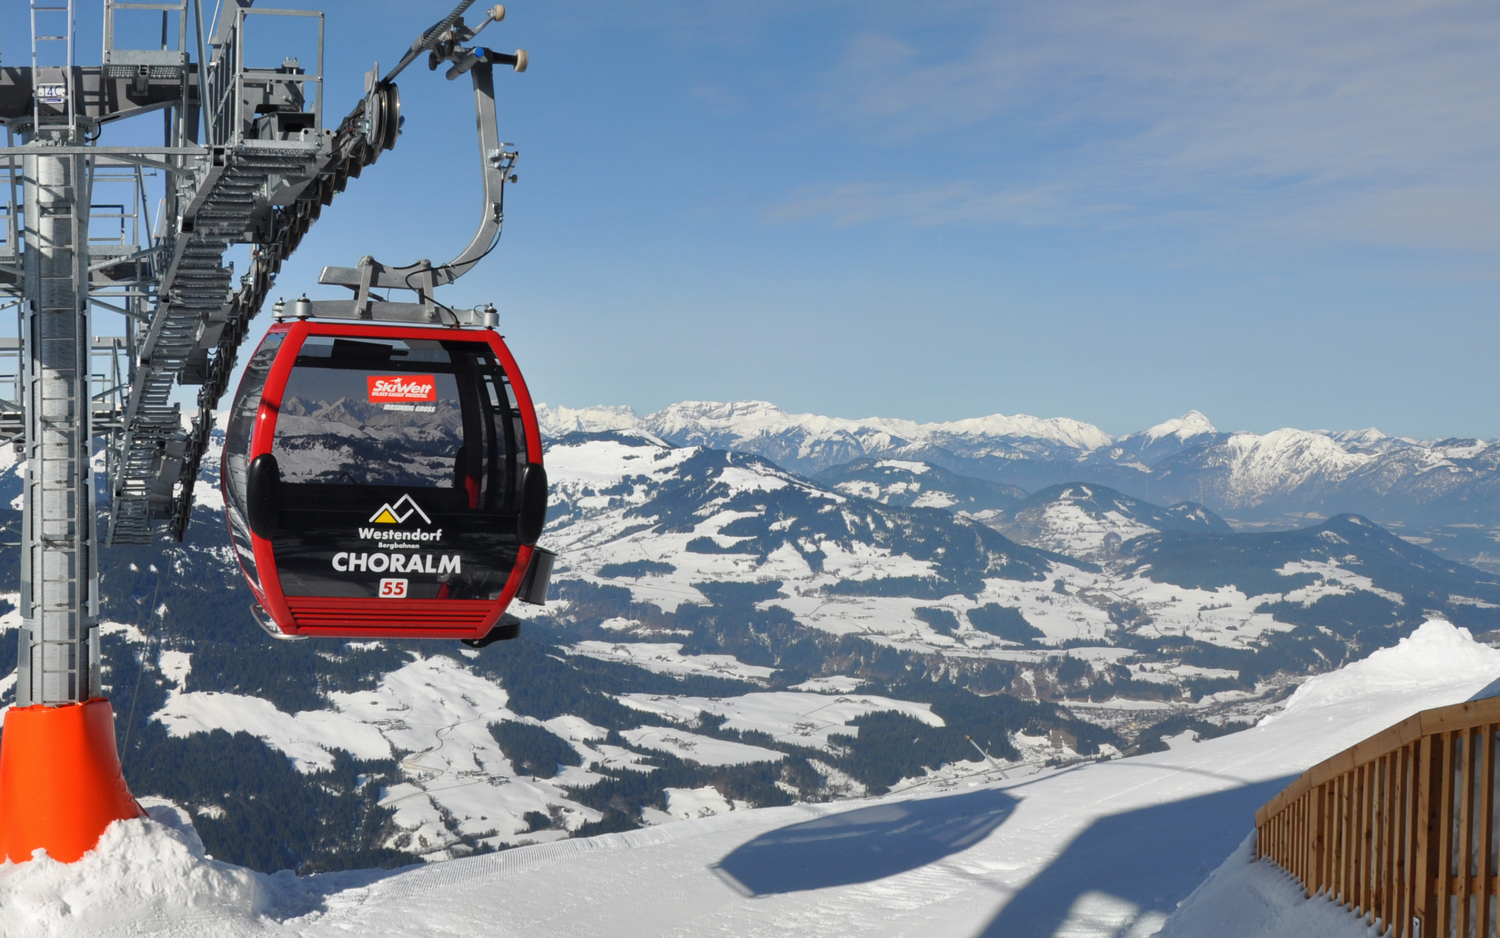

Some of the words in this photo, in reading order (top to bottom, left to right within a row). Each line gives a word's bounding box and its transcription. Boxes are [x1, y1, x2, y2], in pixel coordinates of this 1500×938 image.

[373, 379, 432, 394] SkiWelt
[358, 527, 443, 541] Westendorf
[378, 541, 420, 550] Bergbahnen
[331, 552, 461, 574] CHORALM
[382, 581, 404, 595] 55
